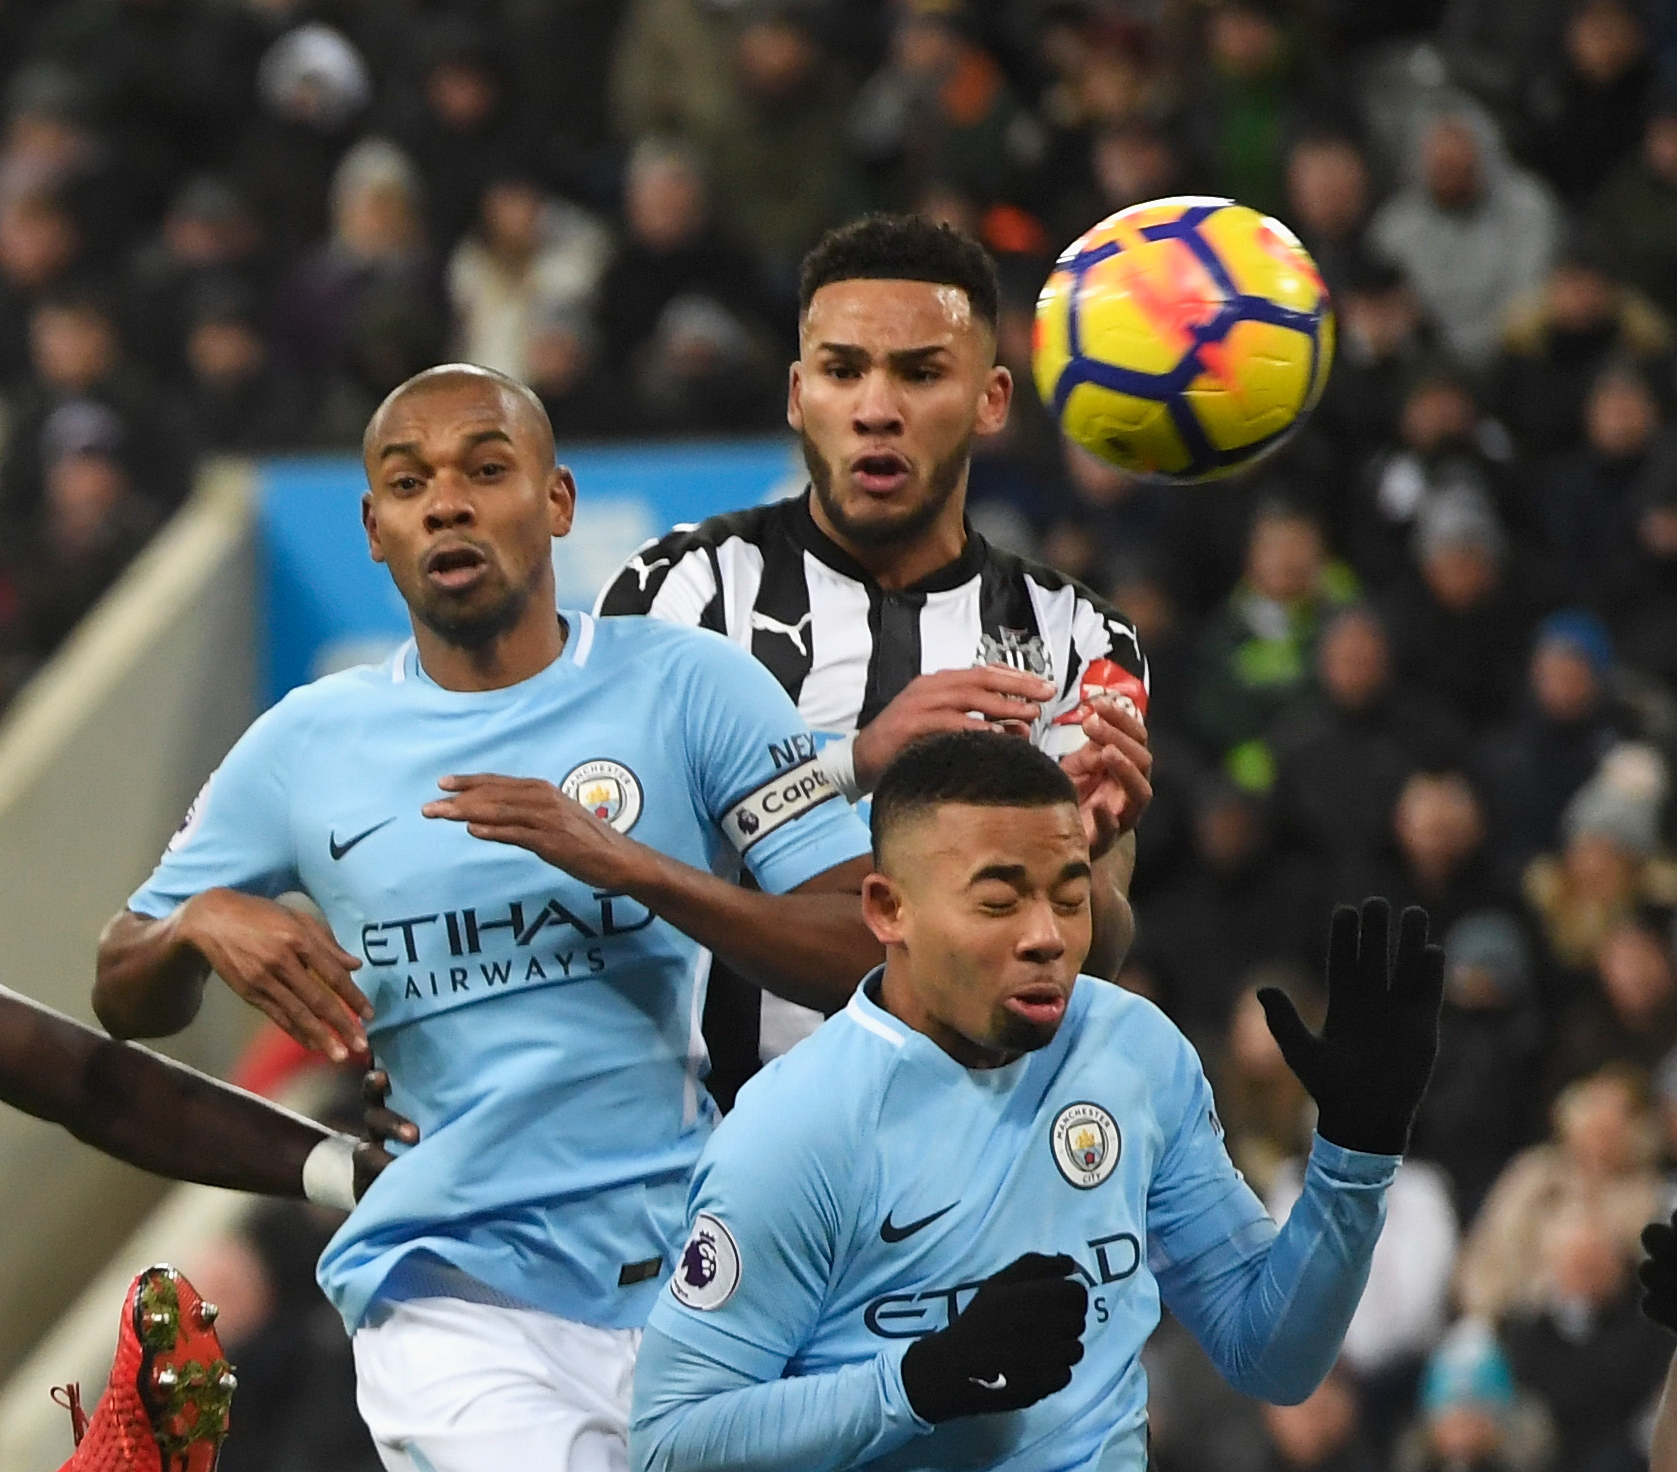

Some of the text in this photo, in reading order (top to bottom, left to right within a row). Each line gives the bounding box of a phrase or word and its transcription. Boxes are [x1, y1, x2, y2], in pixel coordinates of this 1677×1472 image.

[361, 893, 657, 966] ETIHAD
[405, 947, 605, 999] AIRWAYS
[1056, 1107, 1111, 1140] MANCHESTER
[1082, 1172, 1101, 1184] CITY
